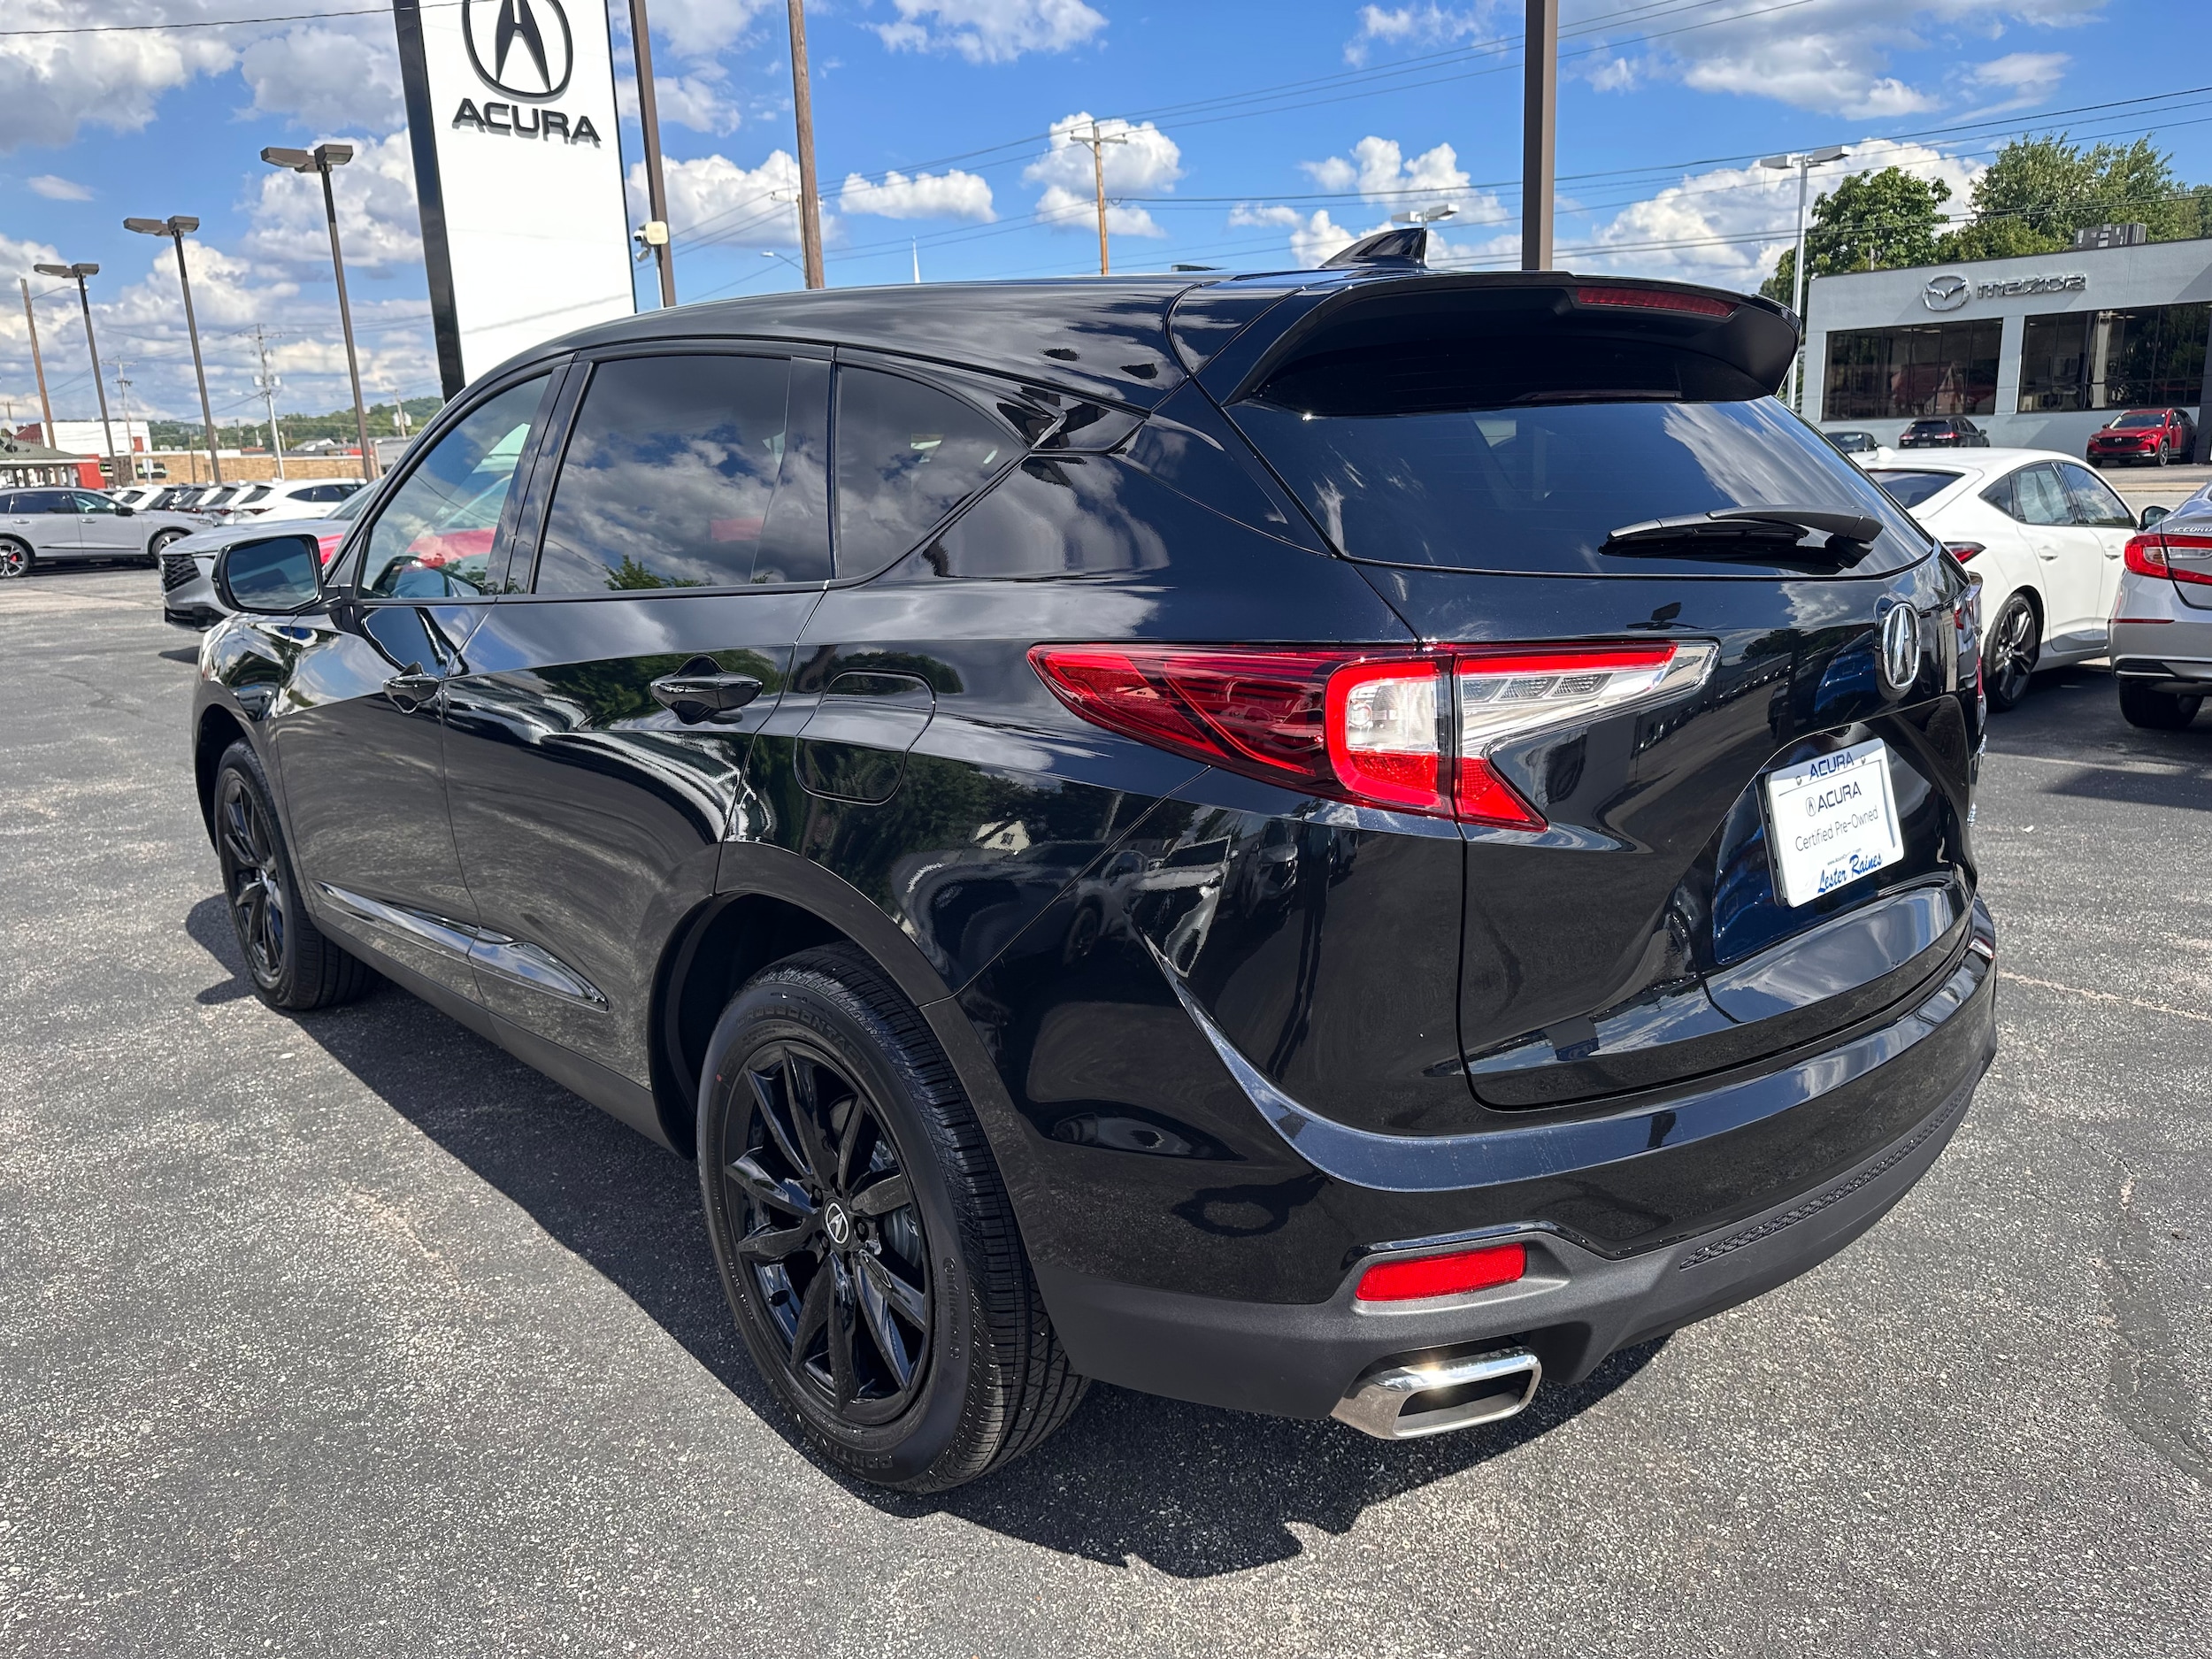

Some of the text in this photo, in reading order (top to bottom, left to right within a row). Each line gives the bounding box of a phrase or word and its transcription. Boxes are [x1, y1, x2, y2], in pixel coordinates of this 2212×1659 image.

[452, 97, 602, 148] ACURA
[1977, 274, 2086, 299] mazda
[1809, 751, 1854, 780] ACURA
[1817, 781, 1862, 812] ACURA
[1795, 805, 1879, 852] Certified Pre-Owned
[1816, 868, 1848, 894] Lester
[1849, 852, 1883, 879] Raines
